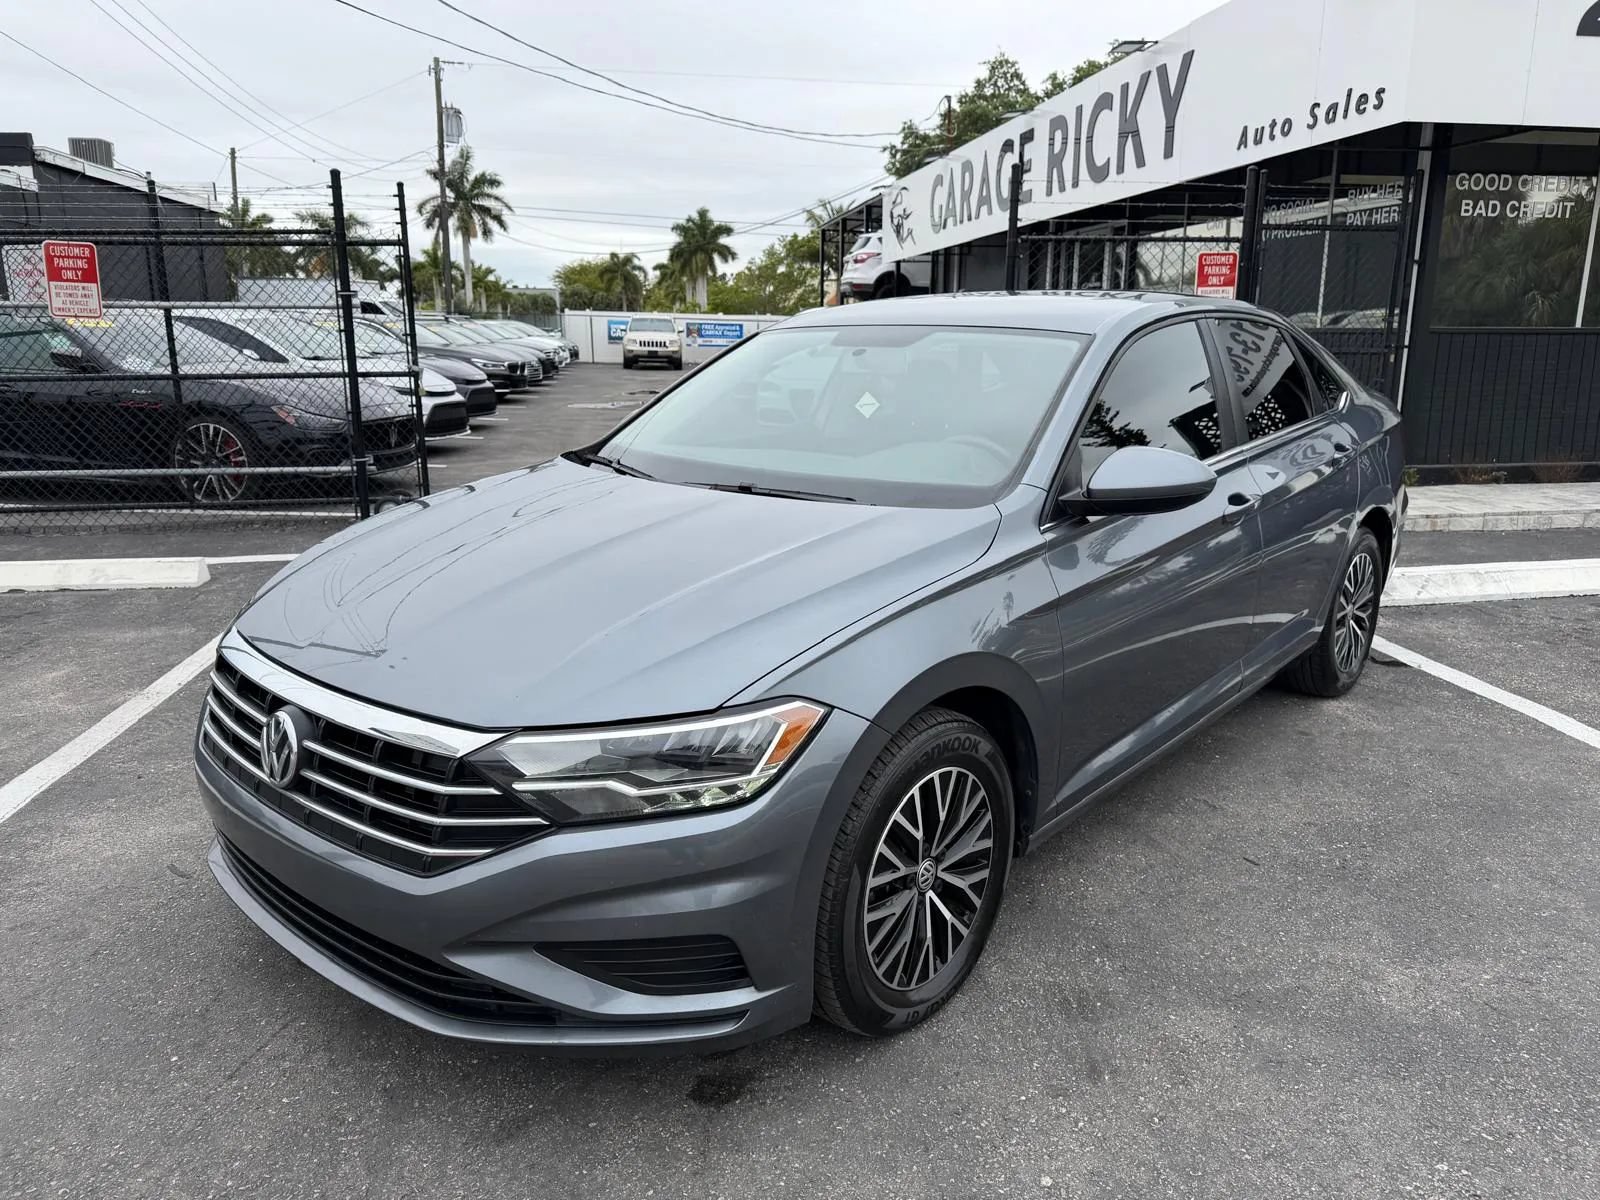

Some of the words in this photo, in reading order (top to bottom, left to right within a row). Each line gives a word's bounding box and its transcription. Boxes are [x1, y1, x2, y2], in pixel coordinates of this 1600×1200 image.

[1237, 117, 1293, 151] Auto
[1306, 87, 1386, 130] Sales
[930, 127, 1035, 234] GARAGE
[1045, 49, 1195, 198] RICKY
[1347, 187, 1375, 201] BUY
[1376, 180, 1403, 199] HER
[1455, 172, 1513, 191] GOOD
[1518, 174, 1587, 195] CREDIT
[1346, 211, 1370, 227] PAY
[1371, 206, 1402, 225] HER
[1460, 199, 1501, 218] BAD
[1506, 200, 1575, 219] CREDIT
[49, 245, 91, 257] CUSTOMER
[53, 257, 88, 269] PARKING
[1201, 255, 1234, 265] CUSTOMER
[61, 269, 82, 280] ONLY
[1203, 265, 1231, 275] PARKING
[1207, 276, 1225, 286] ONLY
